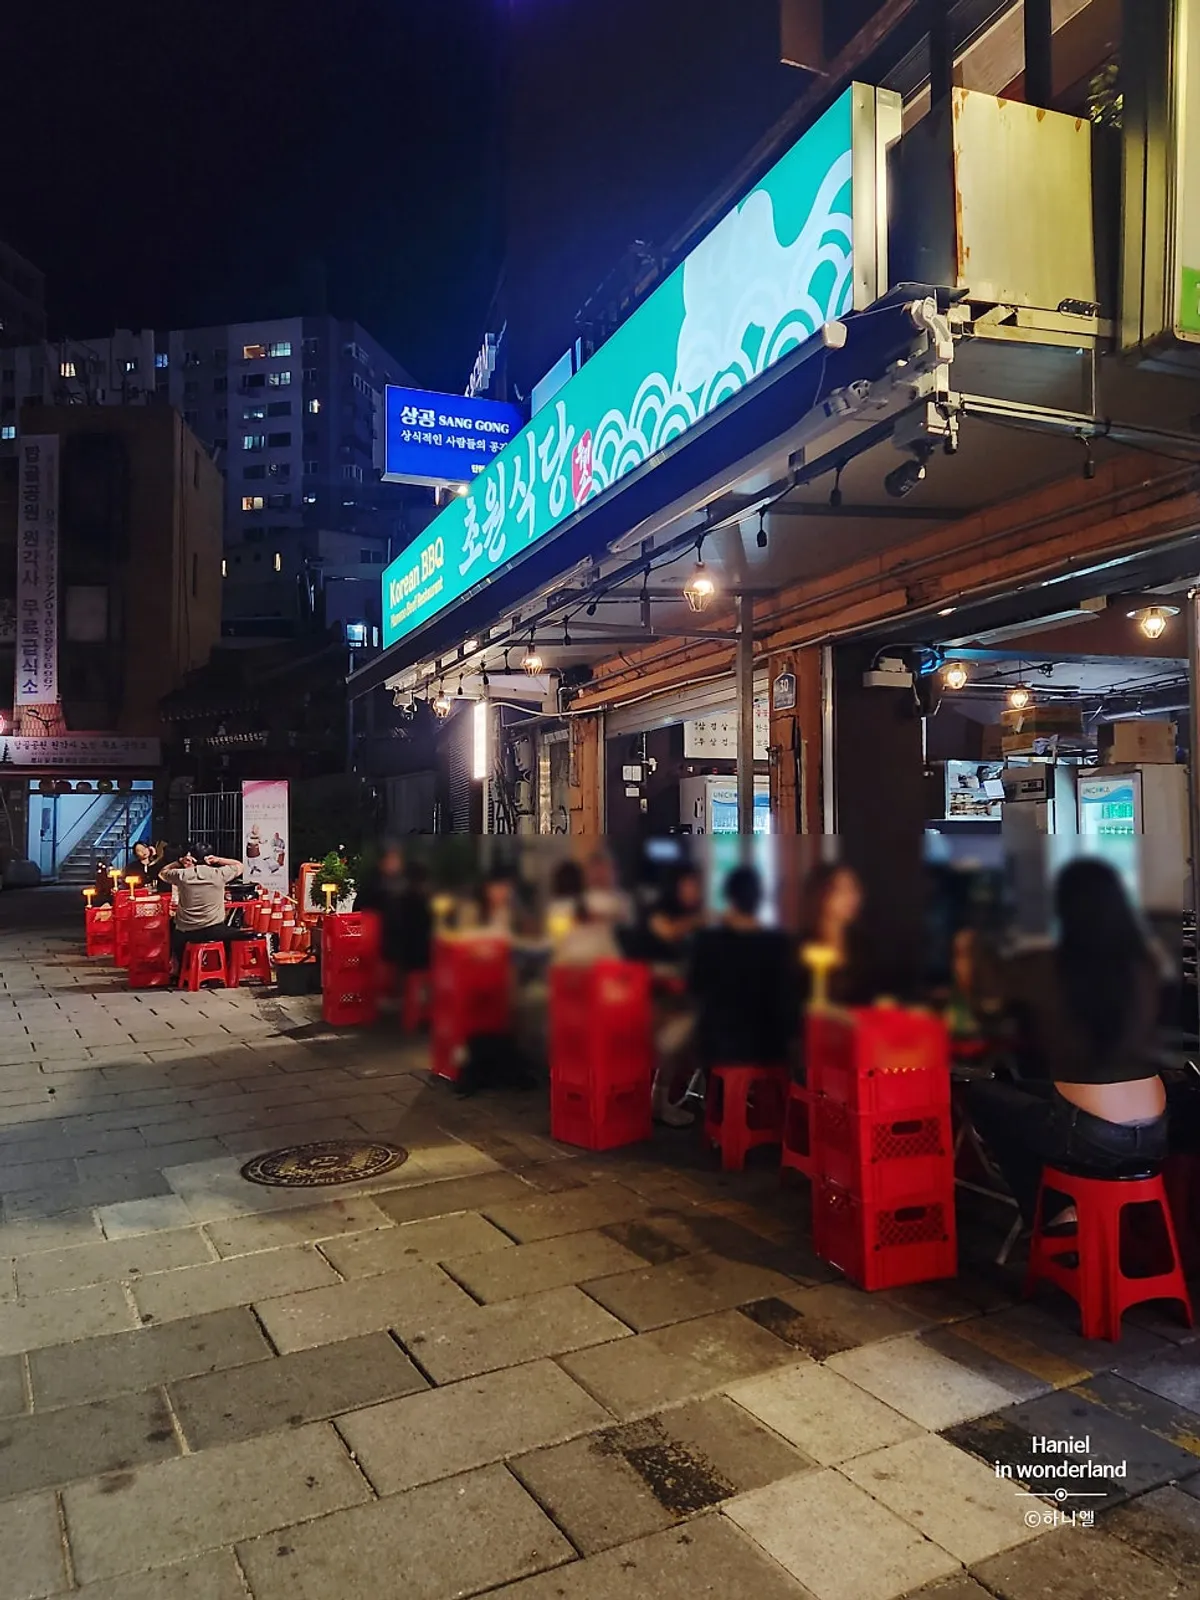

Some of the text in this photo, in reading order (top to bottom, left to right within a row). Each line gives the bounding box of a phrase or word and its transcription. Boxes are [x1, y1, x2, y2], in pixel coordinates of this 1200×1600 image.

[401, 406, 509, 434] 상공 SANG GONG
[401, 430, 442, 446] 상식적인
[446, 435, 486, 451] 사람들의
[459, 400, 575, 576] 초원식당
[22, 530, 40, 587] 원각사
[390, 536, 445, 609] Korean BBQ
